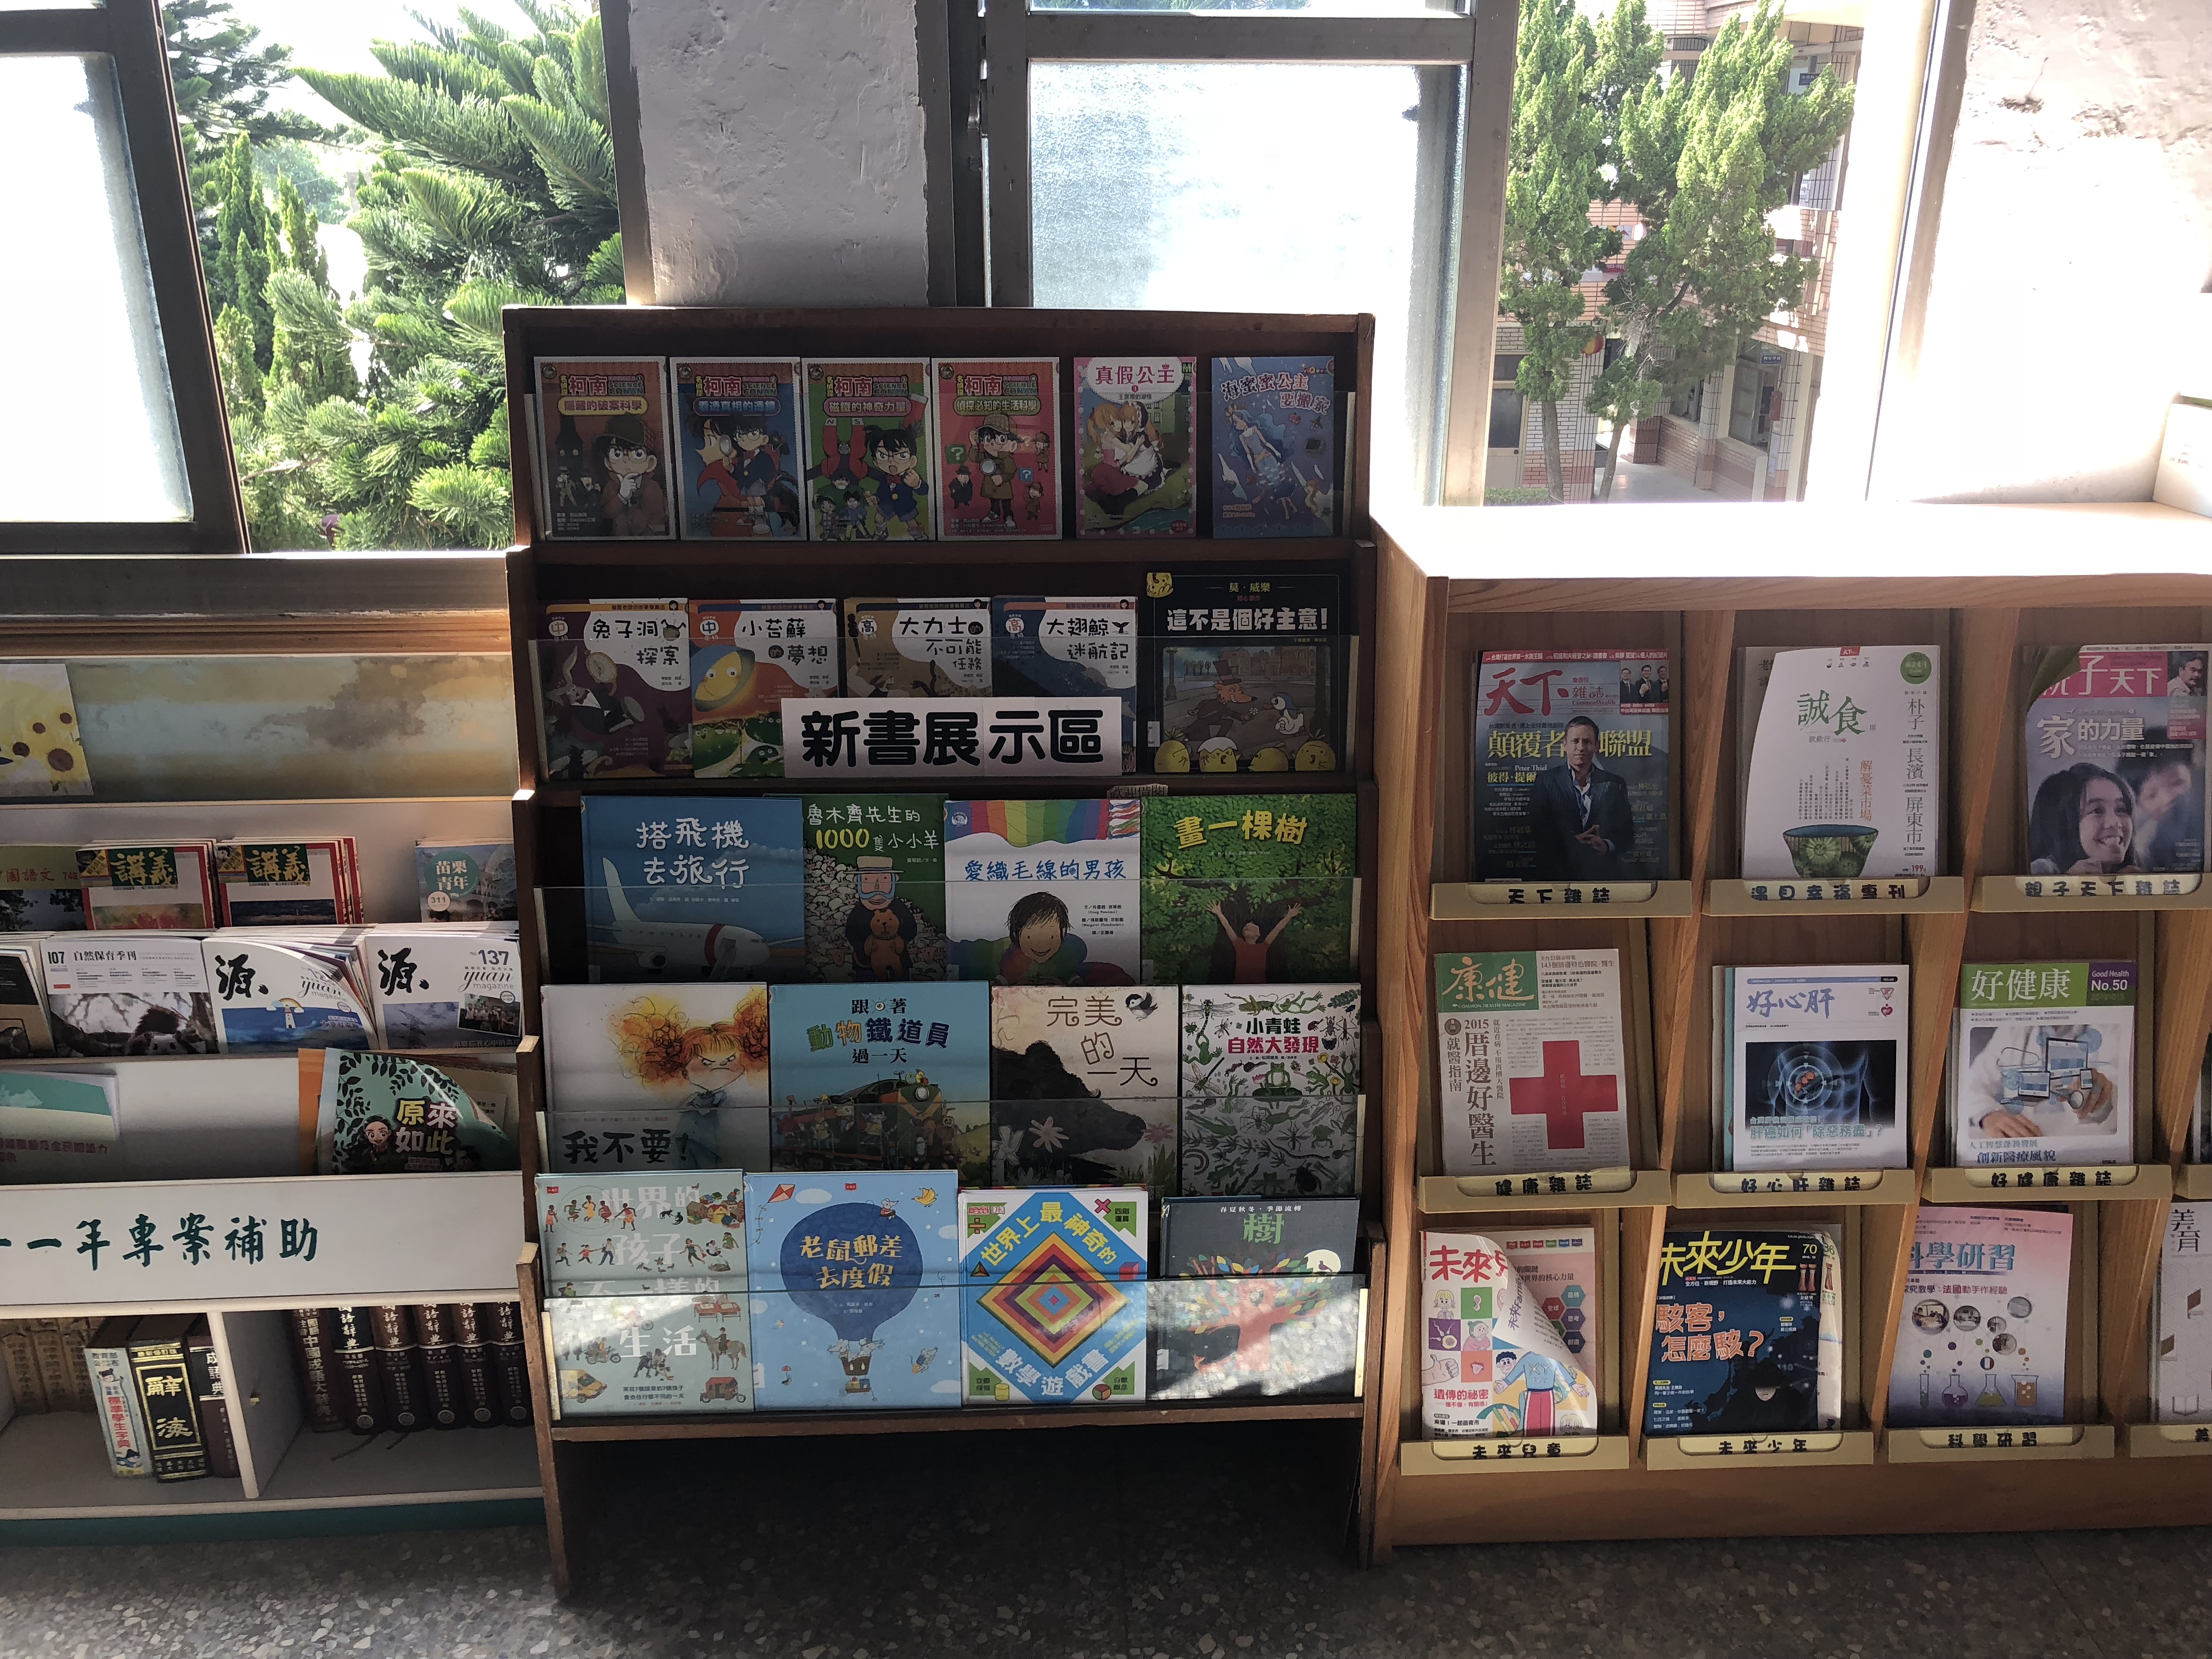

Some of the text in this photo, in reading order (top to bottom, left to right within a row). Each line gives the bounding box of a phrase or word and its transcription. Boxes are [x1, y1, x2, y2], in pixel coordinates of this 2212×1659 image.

[569, 376, 608, 396] 柯南
[703, 376, 741, 396] 柯南
[965, 375, 1002, 396] 柯南
[1095, 366, 1175, 385] 真假公主
[834, 377, 872, 397] 柯南
[1222, 373, 1309, 401] 海蜜蜜公主
[829, 401, 906, 413] 磁鐵的神奇力量
[957, 400, 1038, 411] 偵探必知的生活科學
[1280, 391, 1330, 415] 要搬家
[551, 622, 566, 634] 中
[593, 619, 658, 639] 兔子洞
[702, 621, 716, 634] 中
[742, 618, 806, 638] 小苔蘚
[861, 620, 874, 633] 高
[899, 616, 983, 635] 大力士的
[1008, 619, 1022, 632] 高
[1047, 618, 1109, 636] 大翅鯨
[1167, 607, 1328, 631] 這不是個好主意!
[636, 646, 679, 665] 探案
[769, 645, 828, 665] 的夢想
[926, 639, 982, 656] 不可能
[1067, 642, 1128, 660] 迷航記
[953, 657, 982, 670] 任務
[1483, 667, 1569, 716] 天下
[1572, 686, 1604, 698] 雜誌
[1797, 689, 1869, 736] 誠食
[1906, 698, 1926, 731] 朴子
[801, 709, 1104, 768] 新書展示區
[1488, 730, 1652, 759] 顛覆者 聯盟
[2037, 715, 2145, 759] 家的力量
[1906, 748, 1925, 780] 長濱
[1487, 771, 1537, 783] 彼得·提爾
[1859, 760, 1873, 822] 解憂菜市場
[807, 803, 921, 826] 魯木齊先生的
[1905, 797, 1923, 844] 屏東市
[635, 817, 749, 850] 搭飛機
[1173, 809, 1308, 849] 畫一棵樹
[816, 828, 939, 852] 1000隻小小羊
[0, 867, 55, 883] 國語文
[110, 849, 178, 886] 講義
[246, 845, 311, 887] 講義
[435, 860, 468, 874] 苗栗
[643, 854, 749, 890] 去旅行
[964, 859, 1127, 881] 愛織毛線的男孩
[436, 876, 469, 891] 青年
[2025, 880, 2181, 898] 親子天下雜誌
[1508, 888, 1611, 904] 天下雜誌
[48, 951, 65, 964] 107
[74, 951, 137, 961] 自然保育季刊
[478, 949, 509, 966] 137
[297, 979, 343, 998] yuan
[457, 969, 514, 993] yuan
[1442, 957, 1535, 1003] 康健
[1971, 968, 2070, 1001] 好健康
[2091, 979, 2128, 991] No.50
[311, 991, 348, 1003] magazine
[1746, 988, 1835, 1019] 好心肝
[1046, 995, 1123, 1027] 完美
[806, 1017, 950, 1052] 動物鐵道員
[1245, 1017, 1301, 1035] 小青蛙
[1464, 1019, 1489, 1029] 2015
[1493, 1019, 1501, 1048] 就近看病
[851, 1047, 907, 1064] 過一天
[1081, 1031, 1114, 1065] 的
[1227, 1036, 1319, 1054] 自然大發現
[1086, 1056, 1158, 1087] 一天
[1446, 1037, 1463, 1092] 就醫指南
[1465, 1031, 1497, 1167] 厝邊好醫生
[397, 1100, 459, 1128] 原來
[395, 1129, 453, 1155] 如此
[1750, 1124, 1884, 1139] 肝癌如何「除惡務盡」?
[562, 1128, 688, 1164] 我不要!
[1970, 1139, 2039, 1149] 人工智慧蓬勃發展
[1976, 1150, 2056, 1163] 創新醫療風貌
[1496, 1174, 1593, 1197] 健康雜誌
[1741, 1177, 1861, 1193] 好心肝雜誌
[1990, 1170, 2112, 1187] 好健康雜誌
[601, 1186, 701, 1219] 世界的
[980, 1201, 1118, 1266] 世界上最神奇的
[1243, 1213, 1285, 1245] 樹
[0, 1212, 318, 1272] 一年專案補助
[614, 1232, 681, 1266] 孩子
[799, 1234, 903, 1262] 老鼠郵差
[1802, 1244, 1818, 1255] 70
[1660, 1231, 1797, 1286] 未來少年
[816, 1262, 894, 1289] 去度假
[620, 1324, 698, 1358] 生活
[1661, 1329, 1765, 1363] 怎麼駭?
[995, 1347, 1109, 1396] 數學遊戲書
[1434, 1389, 1489, 1401] 遺傳的祕密
[145, 1375, 194, 1438] 辭海
[1718, 1438, 1808, 1455] 未來少年
[1948, 1431, 2038, 1448] 科學研習
[1472, 1442, 1561, 1459] 未來兒童
